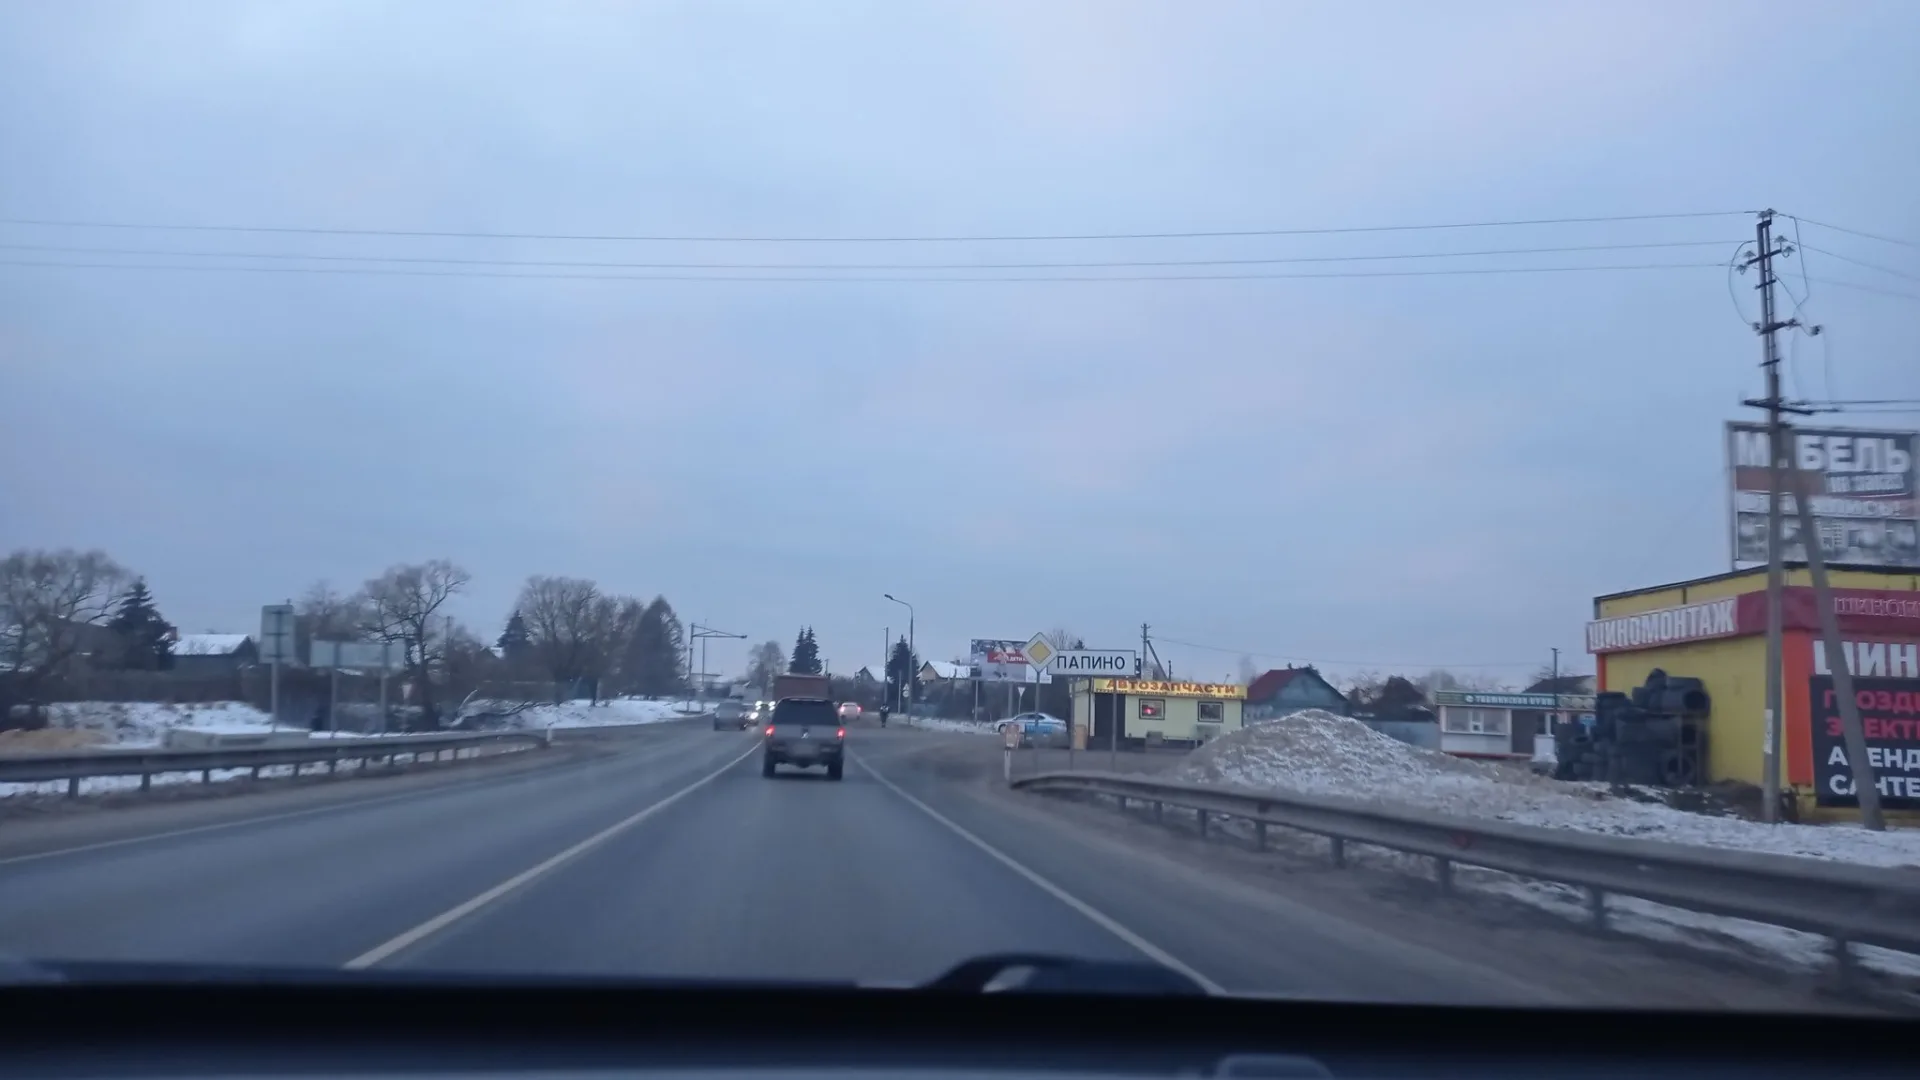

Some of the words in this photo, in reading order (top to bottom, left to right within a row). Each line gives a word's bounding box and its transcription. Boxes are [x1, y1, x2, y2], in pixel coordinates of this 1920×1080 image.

[1735, 431, 1911, 473] МБЕЛЬ
[1588, 599, 1736, 651] ШИНОМОНТАЖ
[1057, 655, 1126, 670] ПАПИНО
[1106, 679, 1237, 694] АВТОЗАПЧАСТИ
[1823, 689, 1920, 714] ГОЗД
[1826, 717, 1920, 740] ЭЕКТ
[1828, 745, 1920, 772] АЕНД
